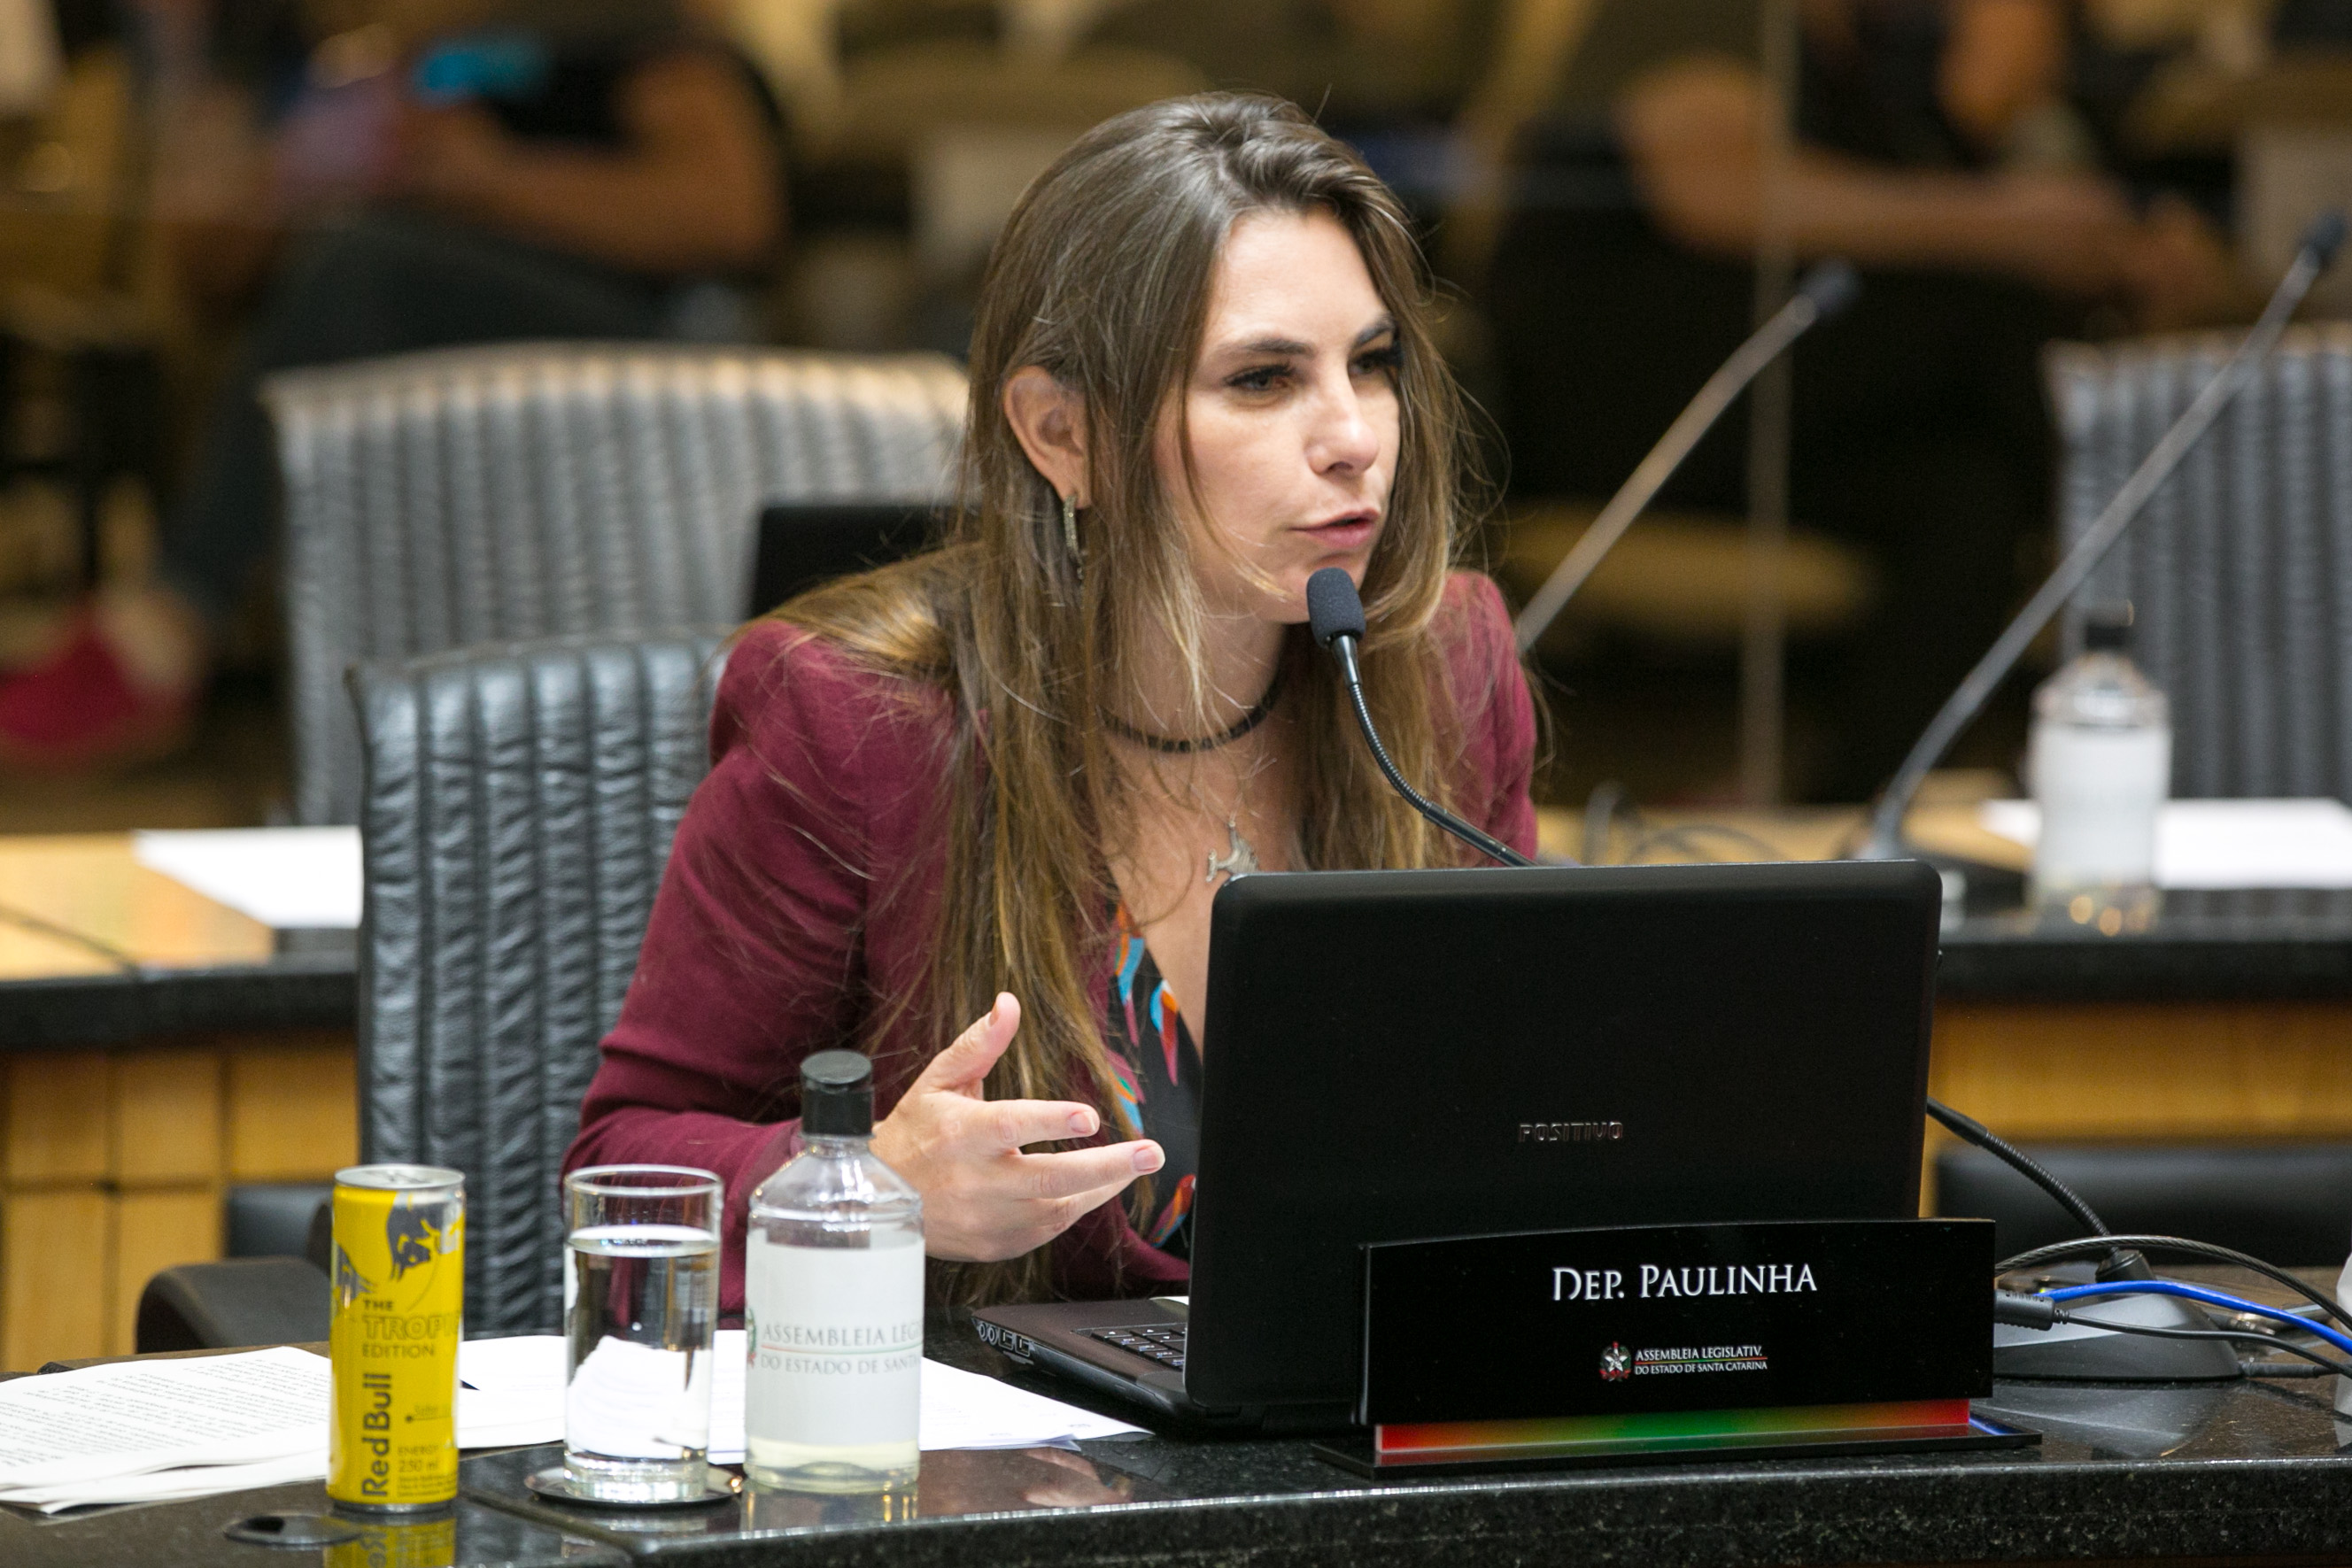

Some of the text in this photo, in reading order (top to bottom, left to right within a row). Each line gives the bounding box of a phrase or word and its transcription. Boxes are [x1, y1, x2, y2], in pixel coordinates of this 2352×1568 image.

[1519, 1121, 1623, 1142] POSITIVO
[363, 1299, 393, 1311] THE
[762, 1324, 886, 1347] ASSEMBLEIA
[362, 1343, 434, 1359] EDITION
[1636, 1348, 1699, 1362] ASSEMBLEIA
[760, 1354, 781, 1370] DO
[785, 1357, 851, 1375] ESTADO
[857, 1359, 878, 1375] DE
[1635, 1361, 1768, 1375] DO ESTADO DE SANTA CATARINA
[360, 1372, 391, 1497] Red Bull
